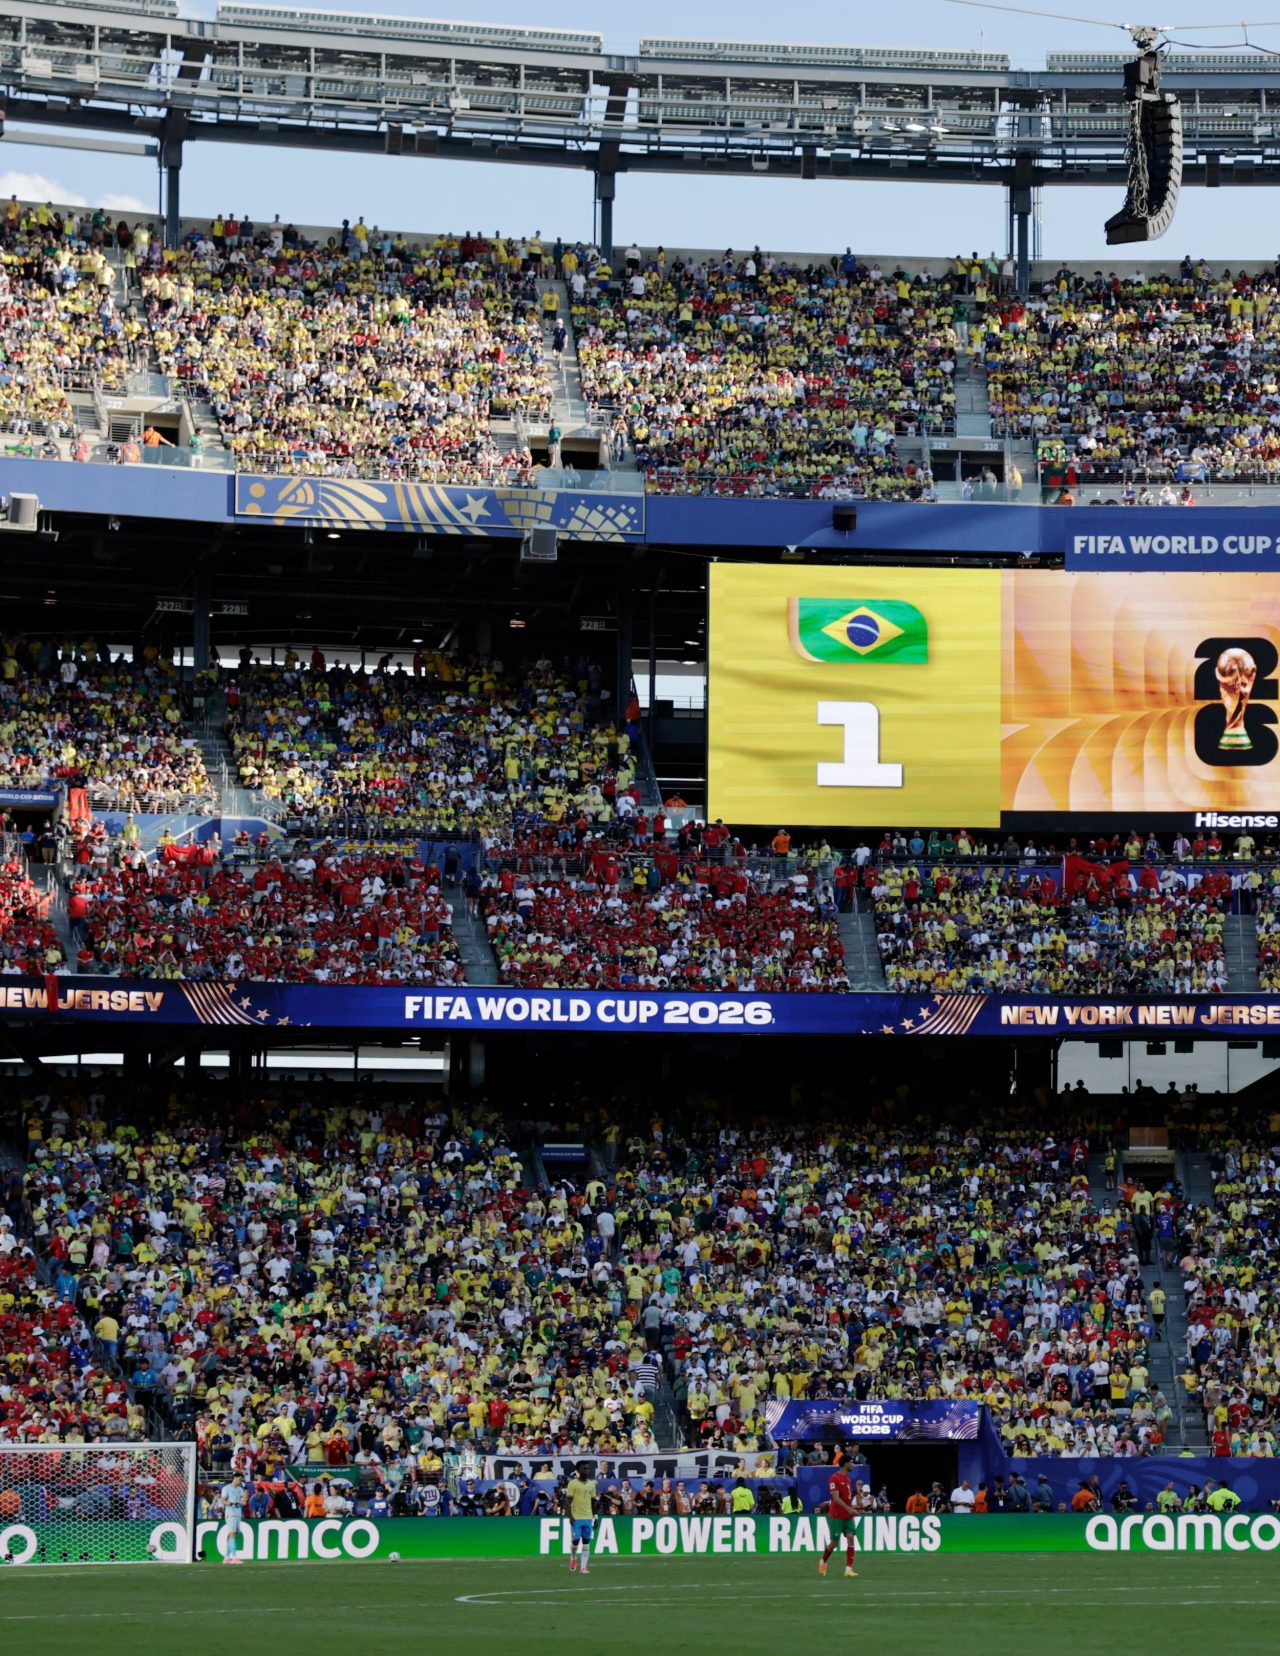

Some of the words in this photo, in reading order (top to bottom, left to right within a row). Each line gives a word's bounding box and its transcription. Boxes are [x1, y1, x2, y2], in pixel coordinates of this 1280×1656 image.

[1073, 535, 1125, 554] FIFA
[1128, 535, 1218, 555] WORLD
[1222, 535, 1272, 555] CUP
[817, 701, 903, 787] 1
[1195, 812, 1279, 829] Hisense
[57, 989, 164, 1012] JERSEY
[404, 995, 472, 1020] FIFA
[477, 997, 591, 1022] WORLD
[597, 999, 658, 1023] CUP
[663, 1000, 772, 1025] 2026
[1001, 1005, 1058, 1025] NEW
[1063, 1005, 1133, 1025] YORK
[1138, 1005, 1196, 1025] NEW
[841, 1415, 880, 1425] WORLD
[881, 1415, 904, 1425] CUP
[860, 1405, 884, 1415] FIFA
[852, 1425, 891, 1435] 2026
[149, 1519, 380, 1560] aramco
[539, 1516, 619, 1554] FIA
[631, 1516, 756, 1554] POWER
